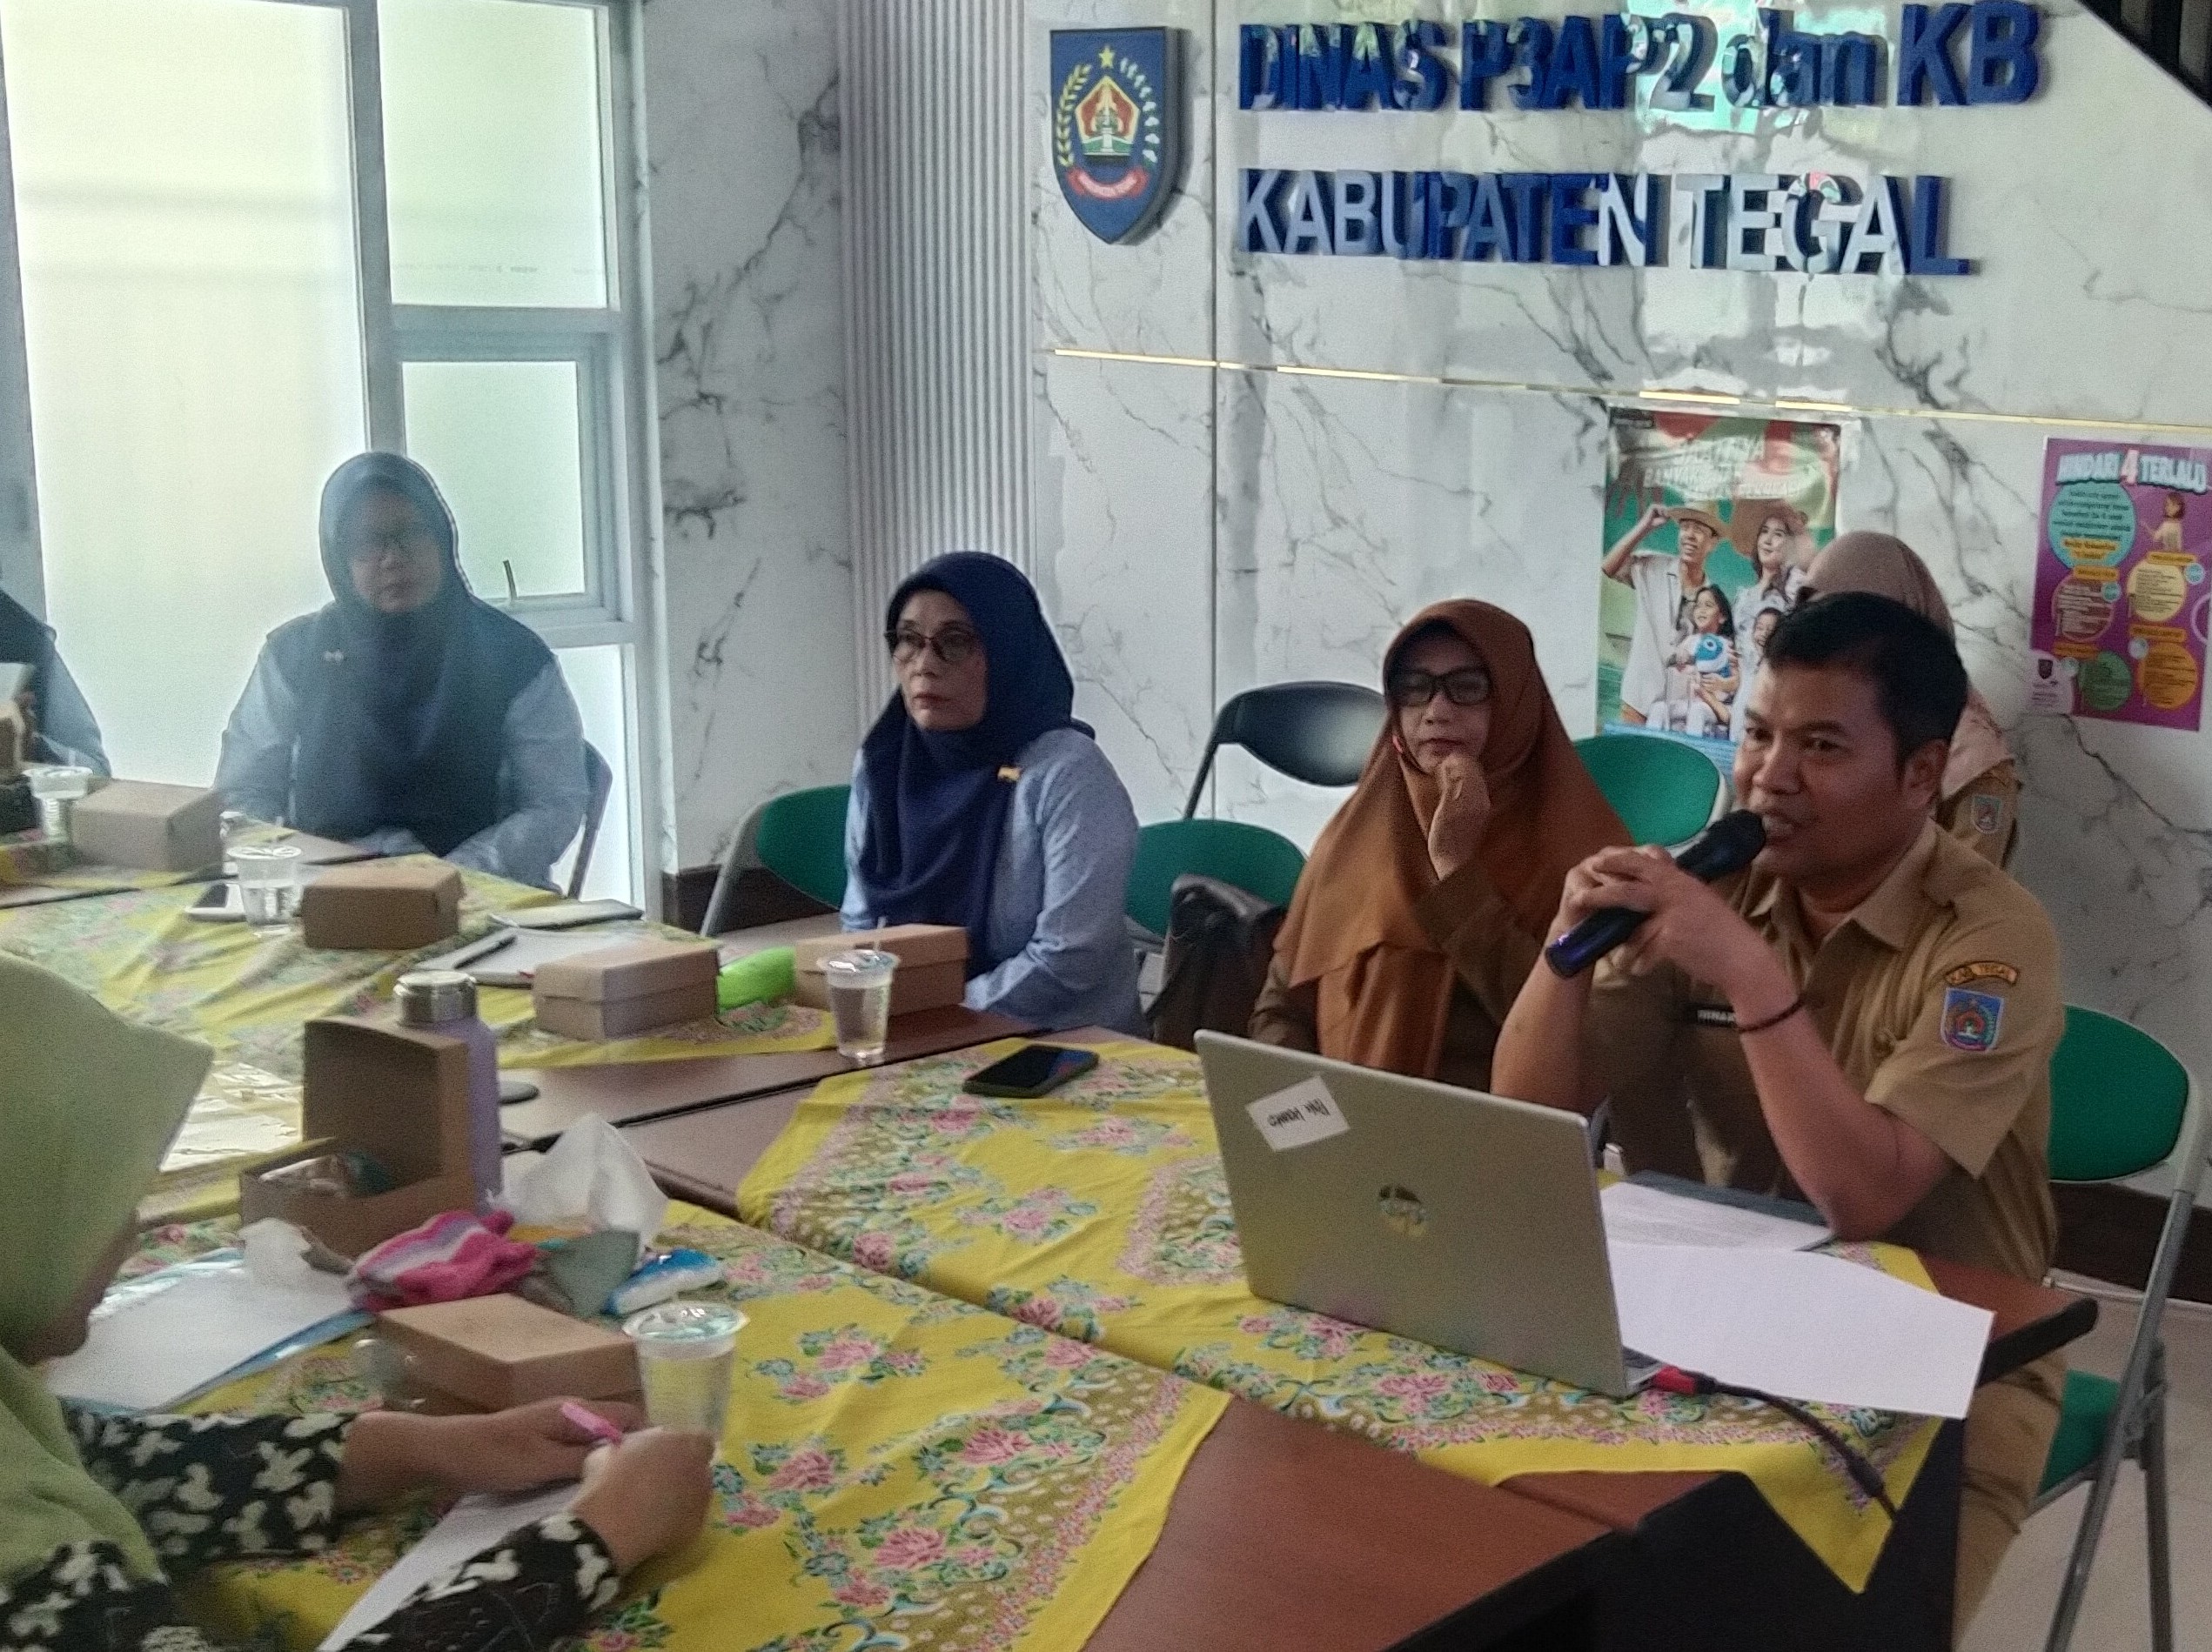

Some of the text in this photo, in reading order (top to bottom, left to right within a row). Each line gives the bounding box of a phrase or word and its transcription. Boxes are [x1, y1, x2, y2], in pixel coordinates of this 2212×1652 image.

[1239, 20, 1455, 110] DINAS
[1460, 13, 1717, 110] P3AP2
[1897, 2, 2043, 106] KB
[1239, 169, 1977, 275] KABUPATEN TEGAL
